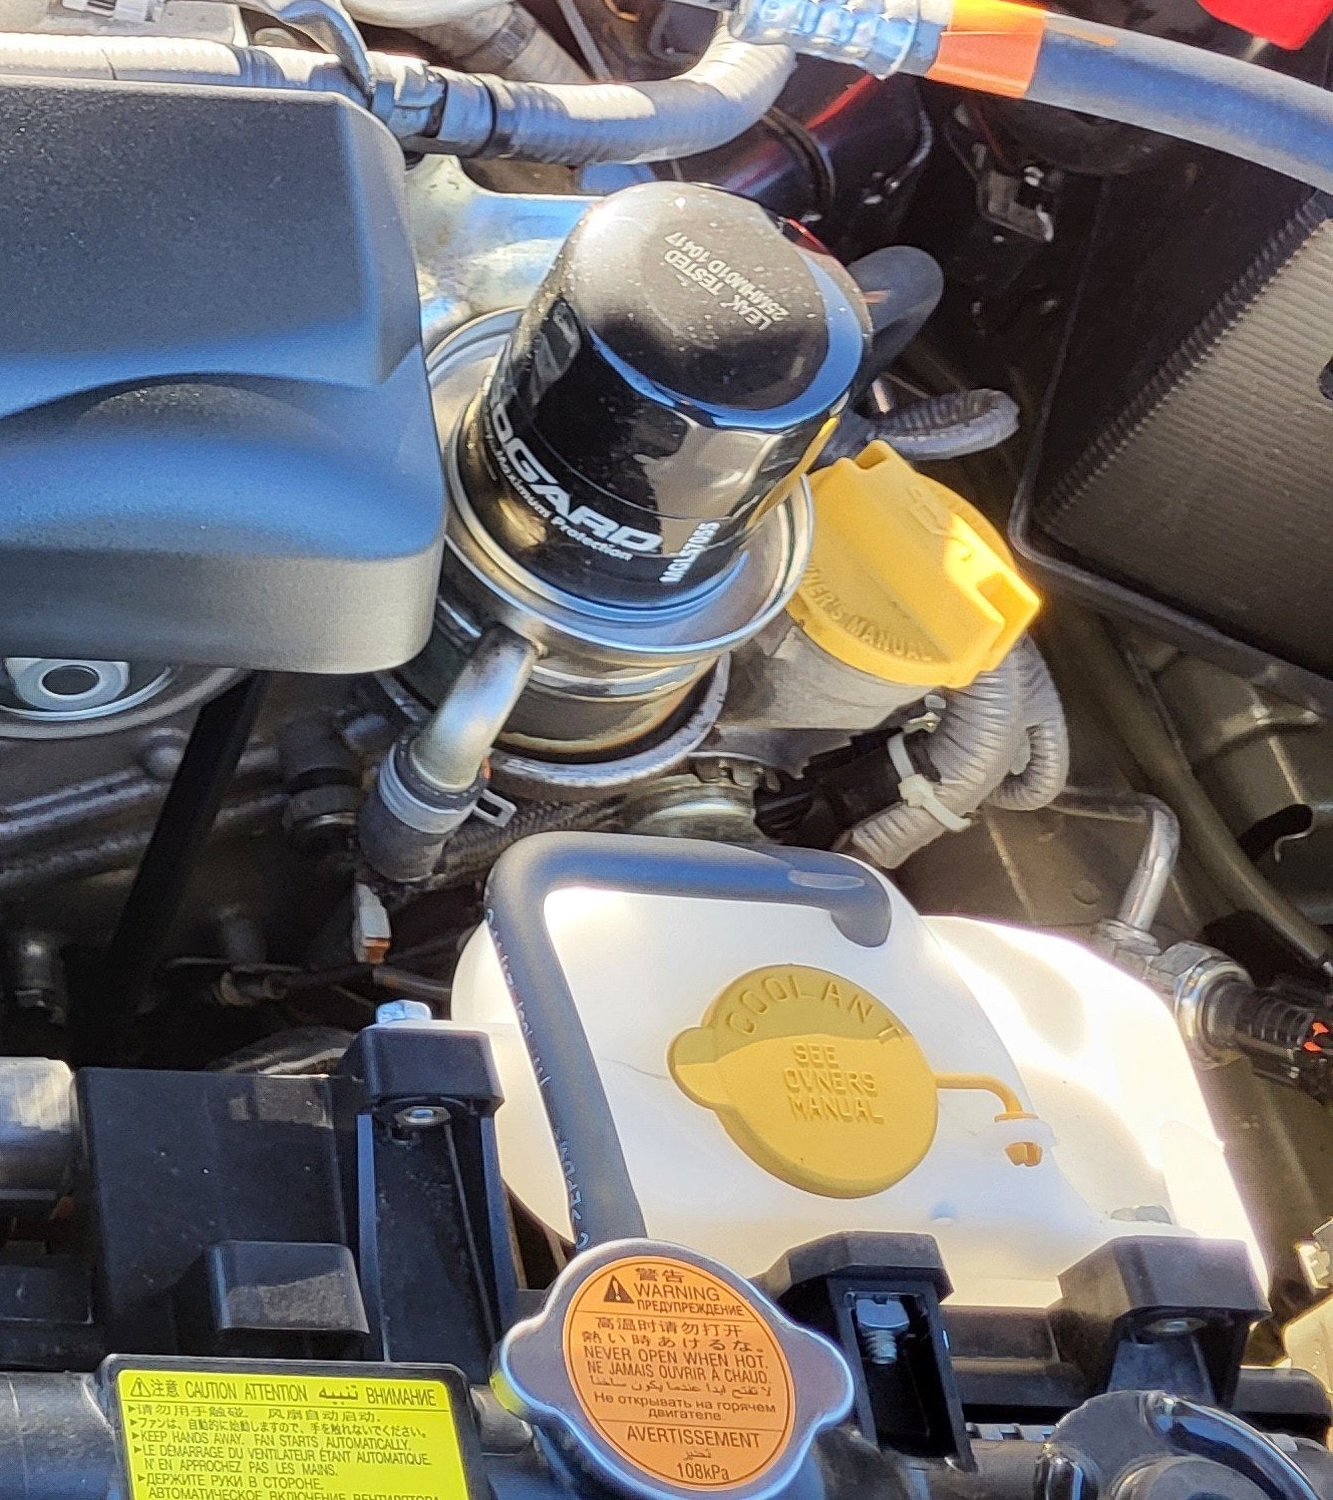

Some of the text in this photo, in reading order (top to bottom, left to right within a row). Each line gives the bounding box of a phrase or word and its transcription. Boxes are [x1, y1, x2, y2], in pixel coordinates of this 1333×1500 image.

[665, 250, 772, 331] LEAK TESTED
[489, 390, 664, 553] OGARD
[493, 448, 633, 561] Maximum Protection
[844, 614, 934, 662] MANUAL
[726, 974, 904, 1045] COOLANT
[793, 1043, 839, 1068] SEE
[788, 1096, 885, 1124] MANUAL
[635, 1267, 685, 1284] 警告
[633, 1282, 721, 1302] WARNING
[637, 1299, 745, 1317] ПРЕДУПРЕЖДЕНИЕ
[595, 1316, 743, 1338] 高温时请勿打开
[584, 1345, 769, 1369] NEVER OPEN WHEN HOT.
[587, 1360, 604, 1374] NE
[609, 1362, 654, 1378] JAMAIS
[659, 1365, 706, 1381] OUVRIR
[151, 1379, 179, 1397] 注意
[185, 1381, 237, 1400] CAUTION
[244, 1382, 307, 1401] ATTENTION
[366, 1387, 437, 1406] ВНИМАНИЕ
[594, 1391, 776, 1415] Не открывать на горячем
[141, 1430, 411, 1451] KEEP HANDS AWAY. FAN STARTS AUTOMATICALLY.
[627, 1425, 761, 1448] AVERTISSEMENT
[142, 1444, 156, 1456] LE
[160, 1442, 225, 1459] DÉMARRAGE
[228, 1447, 244, 1459] DU
[247, 1447, 316, 1462] VENTILATEUR
[320, 1447, 352, 1463] ÉTANT
[180, 1459, 242, 1473] APPROCHEZ
[249, 1461, 269, 1474] PAS
[276, 1462, 295, 1475] LES
[302, 1464, 339, 1477] MAINS.
[677, 1462, 730, 1481] 108kPa
[146, 1472, 324, 1490] ДЕРЖИТЕ РУКИ В СТОРОНЕ.
[148, 1486, 263, 1500] АВТОМАТИЧЕСКОЕ
